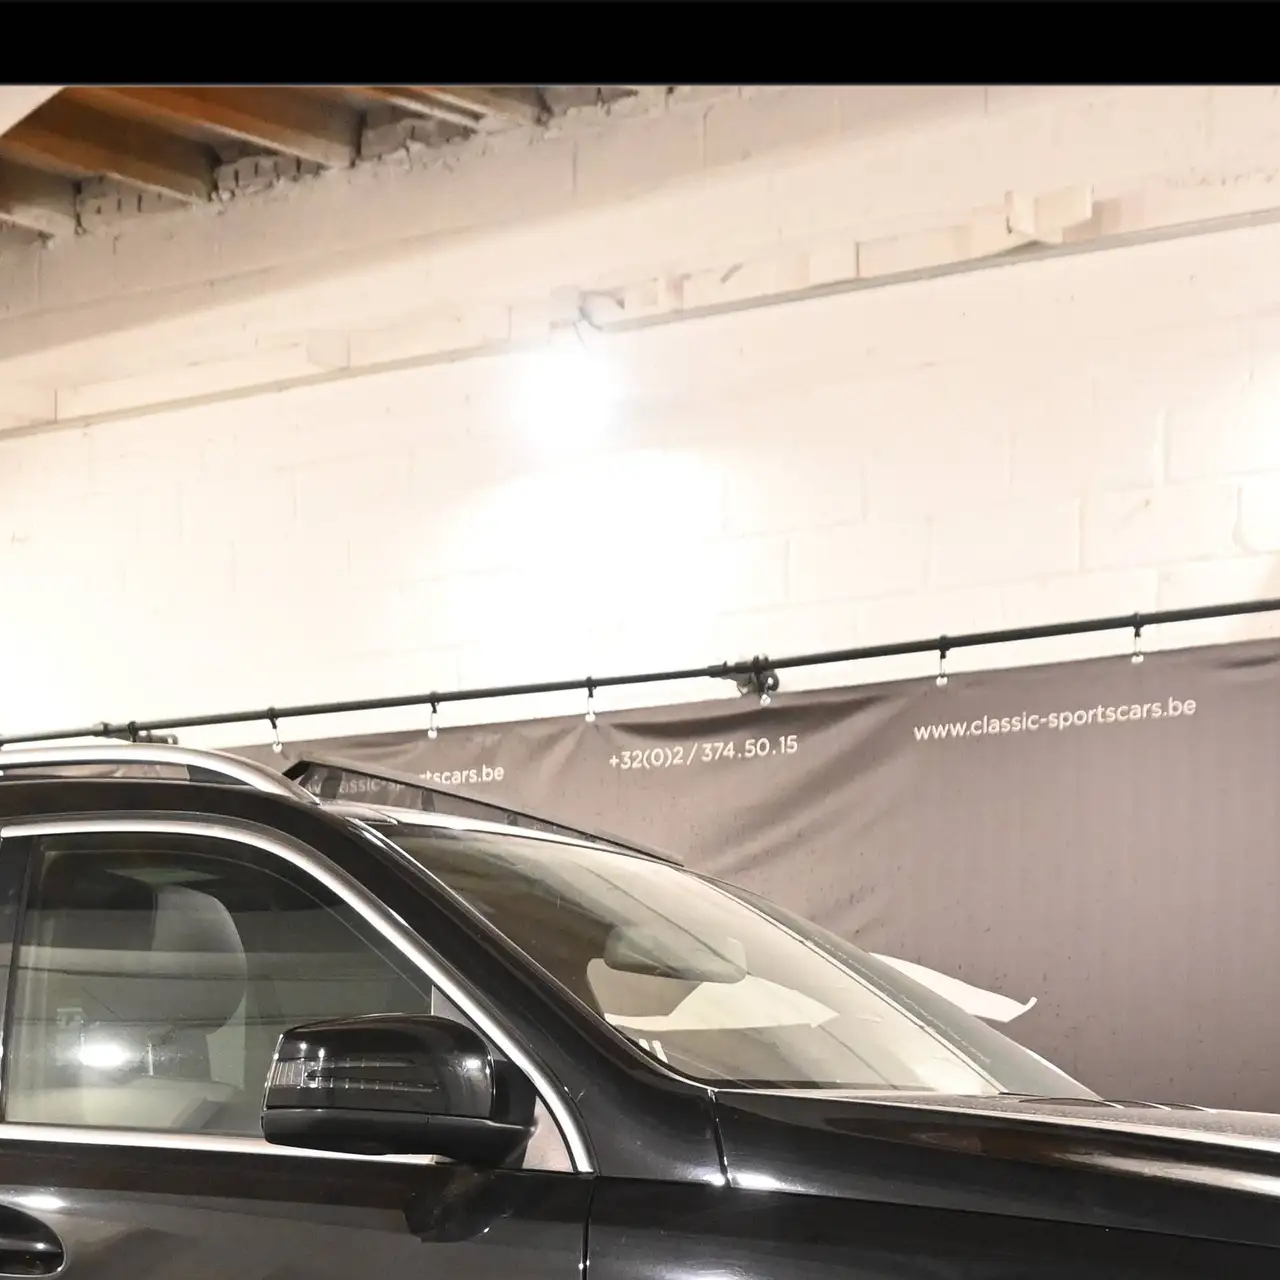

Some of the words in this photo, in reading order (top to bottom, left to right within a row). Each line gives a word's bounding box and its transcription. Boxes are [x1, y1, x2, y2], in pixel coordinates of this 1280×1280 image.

[913, 696, 1198, 742] www.classic-sportscars.be
[609, 745, 685, 770] +32(0)2
[701, 734, 799, 762] 374.50.15
